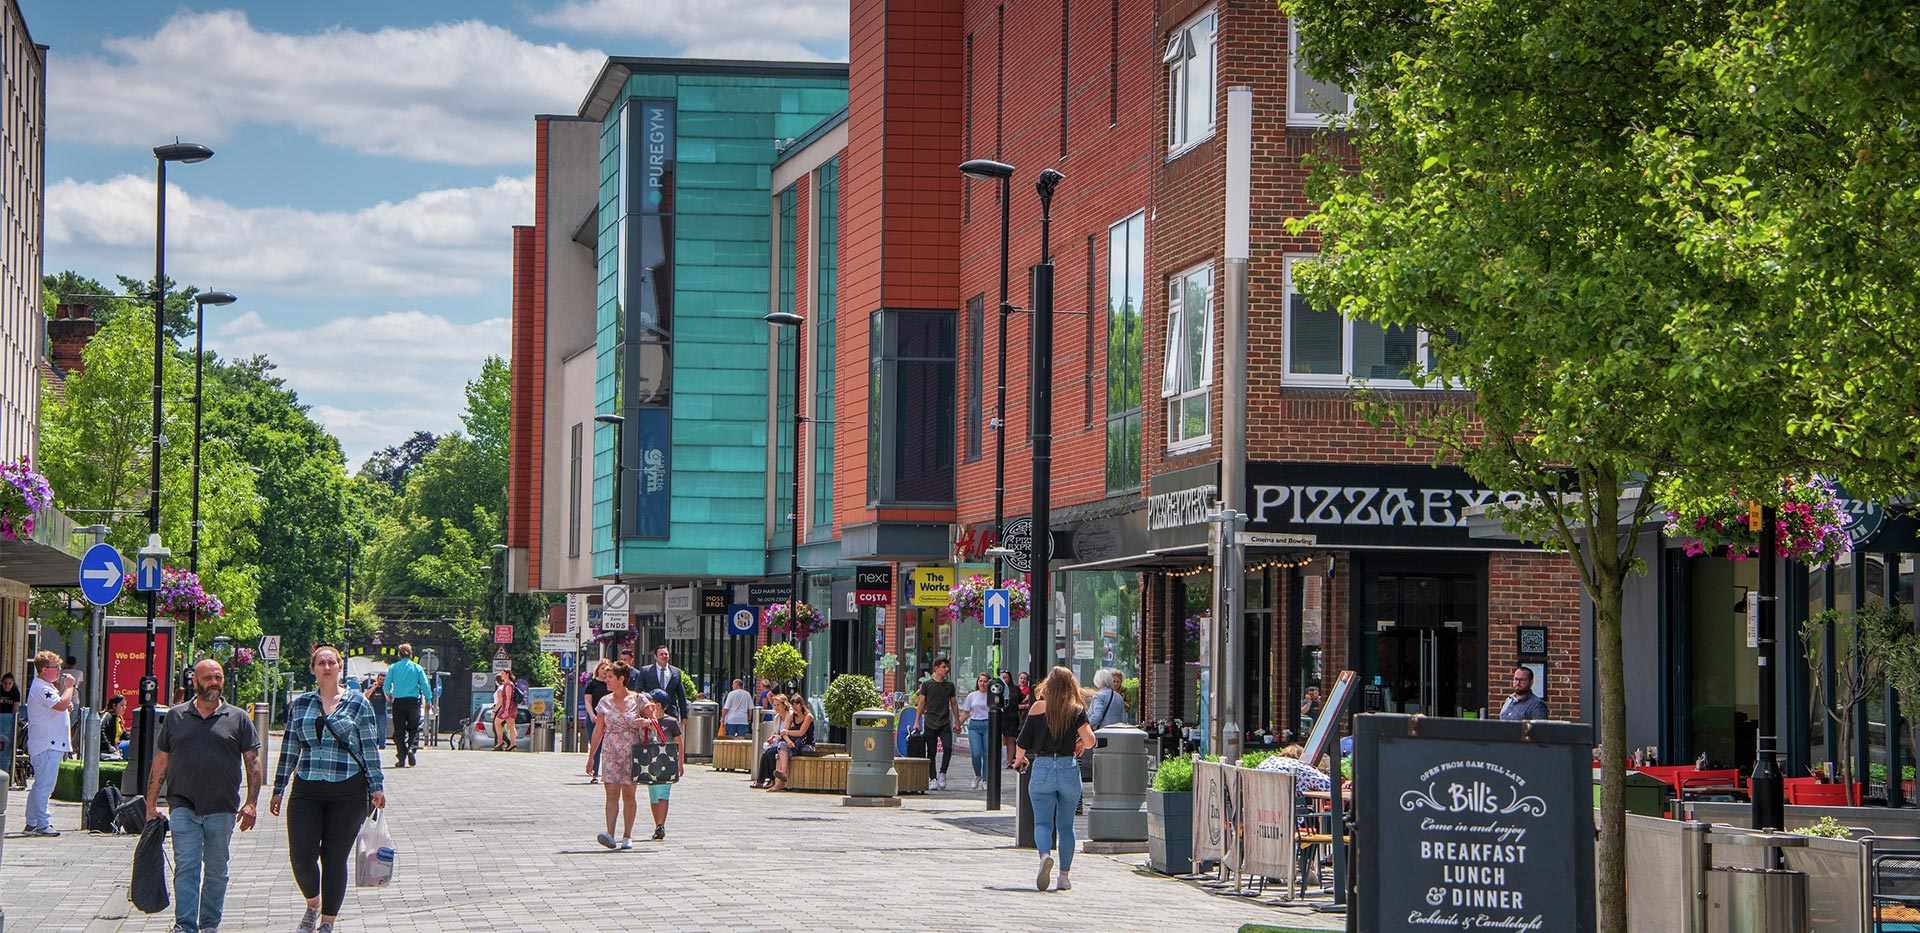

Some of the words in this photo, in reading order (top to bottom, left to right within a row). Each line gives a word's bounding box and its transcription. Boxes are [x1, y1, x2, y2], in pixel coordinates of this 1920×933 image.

[649, 108, 665, 188] PUREGYM
[1147, 485, 1209, 531] PIZZAEXPRESS
[1250, 536, 1274, 544] Cinema
[1288, 537, 1313, 546] Bowling
[858, 572, 889, 584] next
[920, 582, 950, 592] Works
[926, 572, 944, 582] The
[860, 593, 888, 602] COSTA
[1420, 765, 1440, 782] OPEN
[1441, 760, 1464, 772] FROM
[1485, 762, 1505, 774] TILL
[1505, 769, 1526, 787] LATE
[1448, 781, 1498, 813] Bill's
[1420, 817, 1453, 831] Come
[1454, 821, 1468, 831] in
[1469, 821, 1494, 833] and
[1494, 824, 1528, 843] enjoy
[1420, 841, 1527, 863] BREAKFAST
[1443, 865, 1505, 885] LUNCH
[1426, 887, 1447, 906] &
[1452, 888, 1523, 909] DINNER
[1407, 909, 1459, 926] Cocktails
[1461, 916, 1475, 930] &
[1475, 914, 1545, 933] Candlelight
